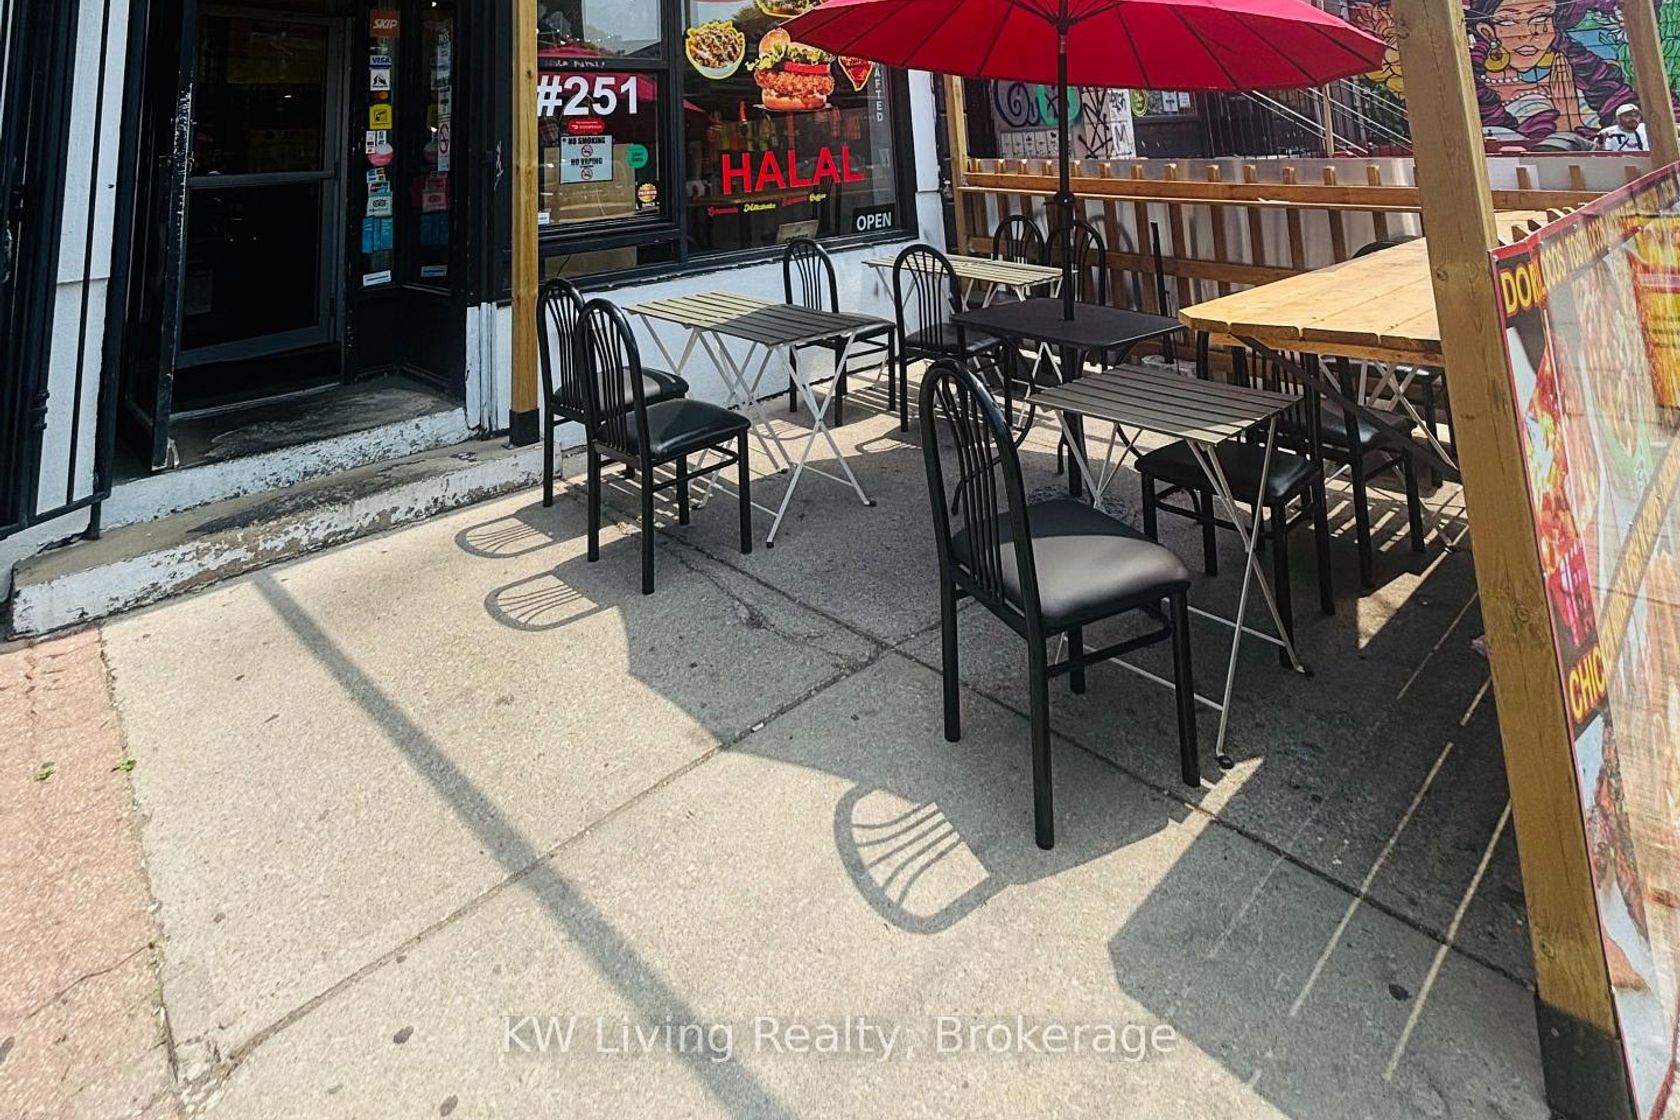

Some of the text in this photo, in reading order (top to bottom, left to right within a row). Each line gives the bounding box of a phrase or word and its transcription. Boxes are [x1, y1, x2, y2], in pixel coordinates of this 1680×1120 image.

[373, 19, 398, 29] SKIP
[372, 56, 390, 64] VISA
[537, 74, 638, 117] #251
[872, 62, 885, 123] AFTED
[568, 136, 606, 145] NO SMOKING
[721, 143, 865, 196] HALAL
[856, 211, 892, 231] OPEN
